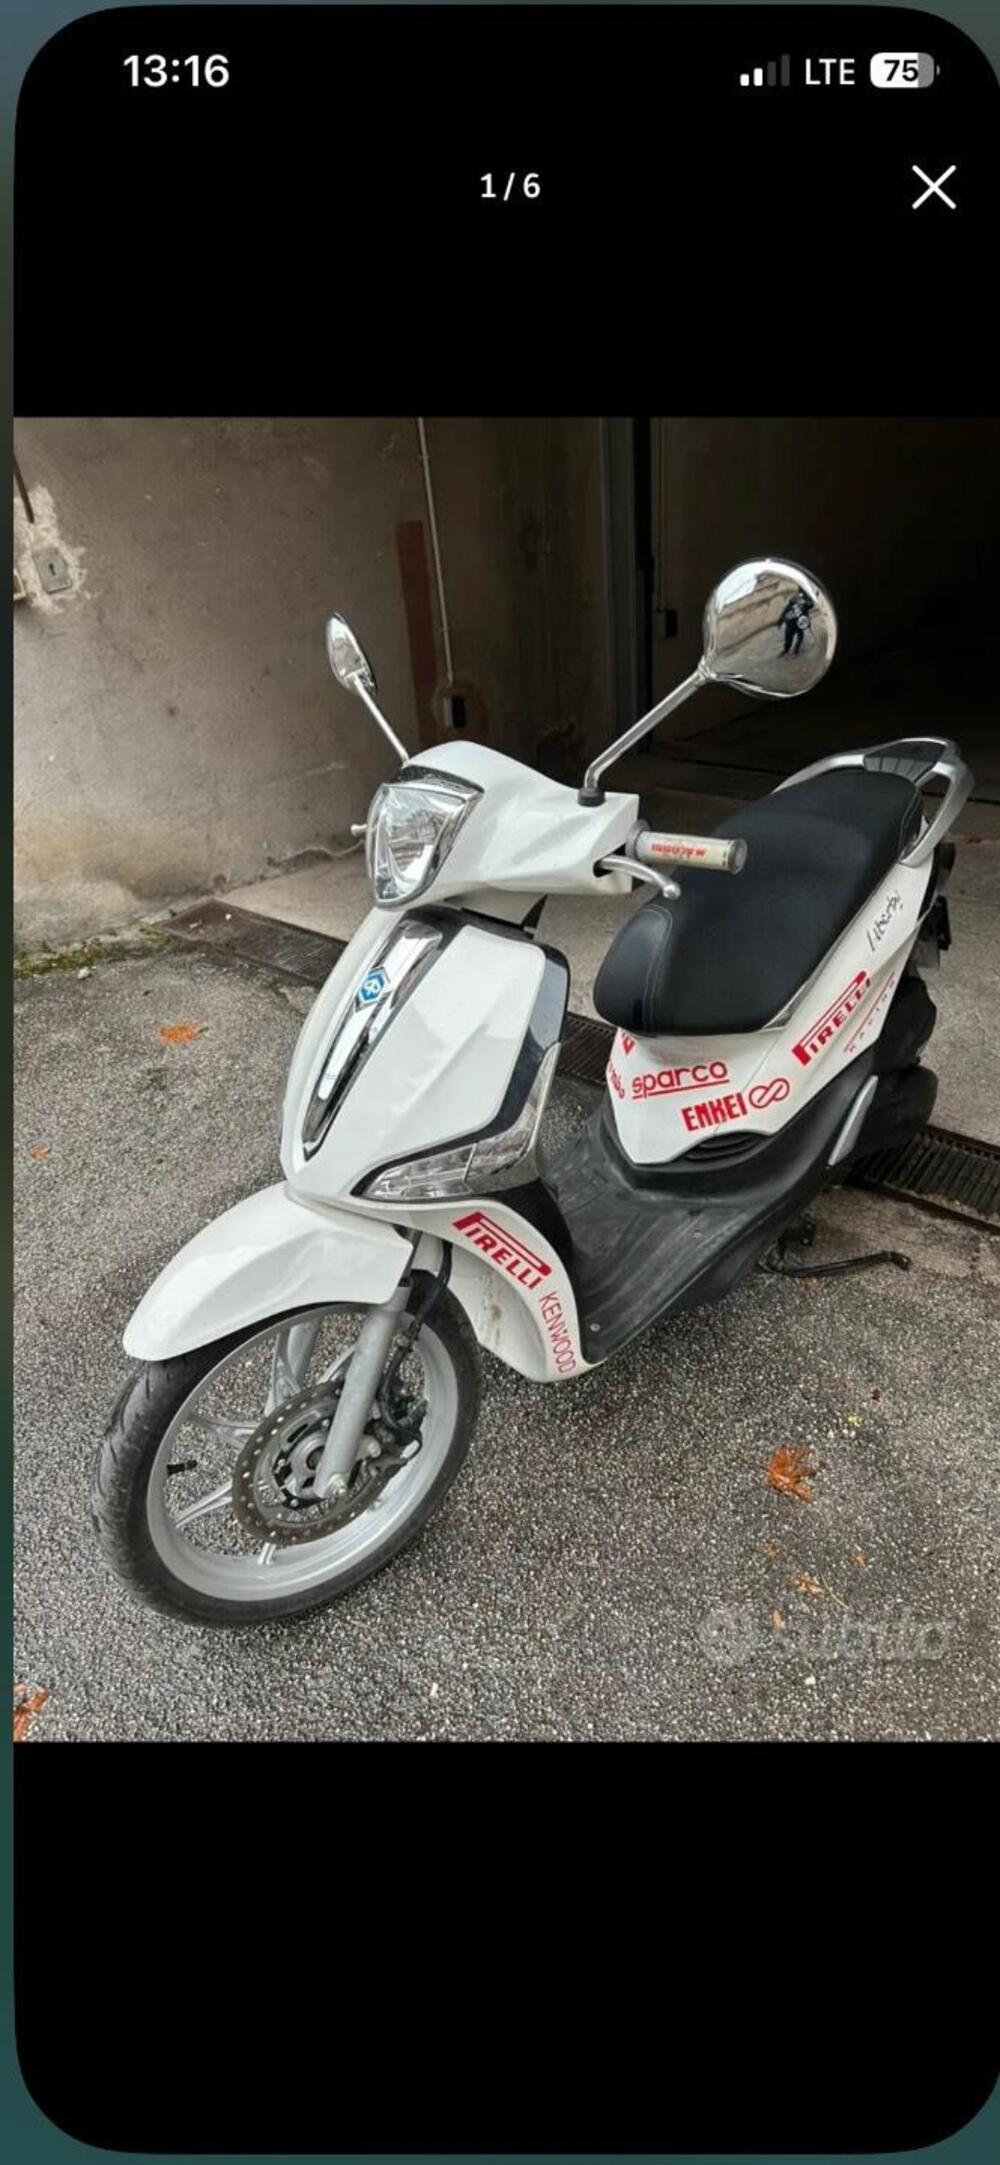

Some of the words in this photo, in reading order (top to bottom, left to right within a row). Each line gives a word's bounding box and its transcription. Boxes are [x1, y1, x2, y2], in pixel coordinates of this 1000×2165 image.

[792, 970, 872, 1066] PIRELLI
[632, 1061, 729, 1098] sparco
[681, 1092, 748, 1132] ENKEI
[452, 1211, 552, 1290] PIRELLI
[540, 1291, 577, 1373] KENWOOD
